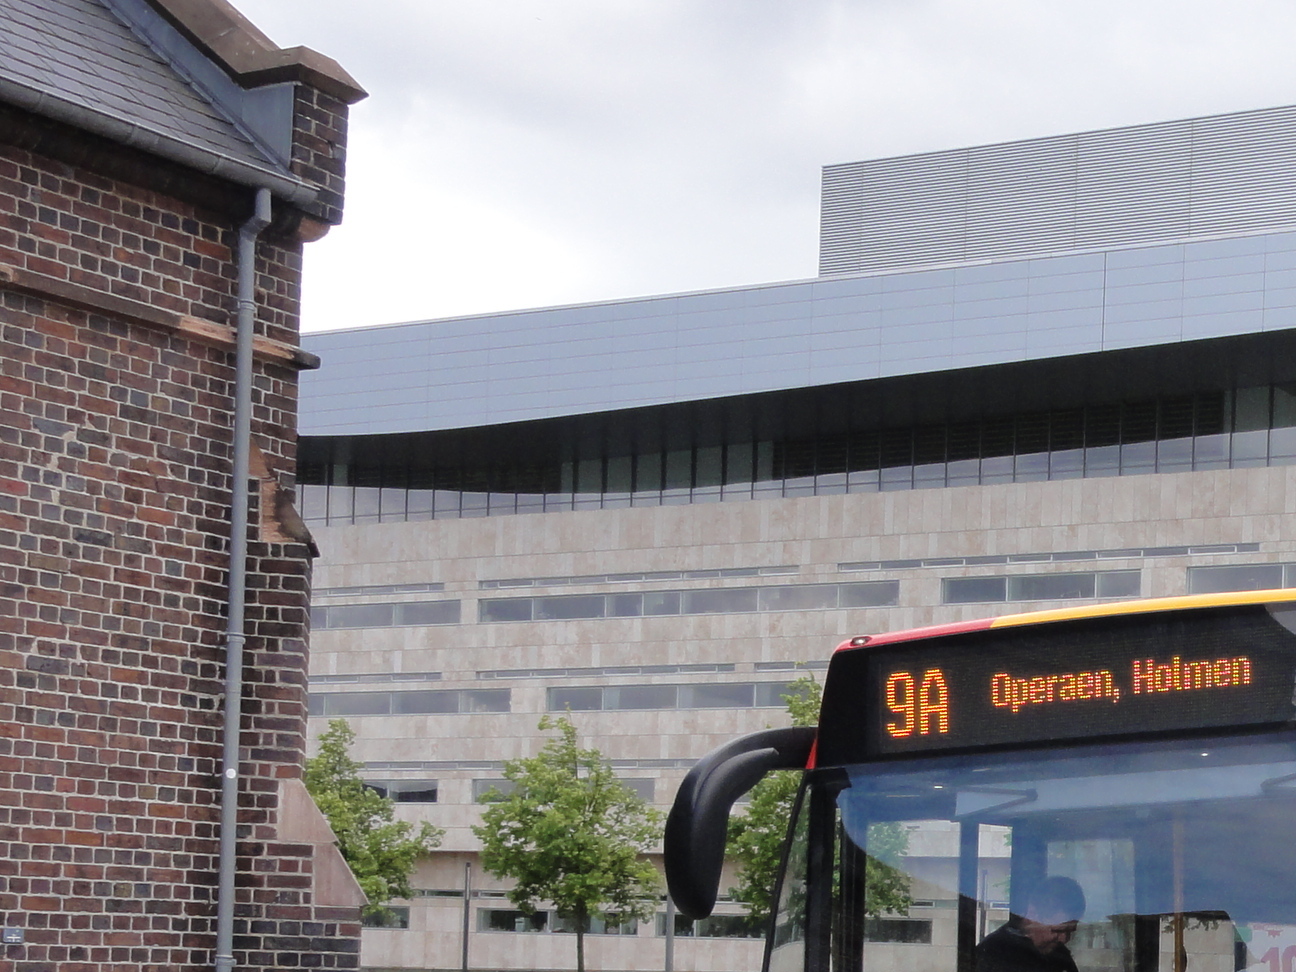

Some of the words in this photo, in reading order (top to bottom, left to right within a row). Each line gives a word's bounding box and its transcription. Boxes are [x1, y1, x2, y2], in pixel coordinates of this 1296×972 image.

[886, 668, 949, 738] 9A
[991, 671, 1121, 713] Operaen,
[1132, 655, 1251, 695] Holmen
